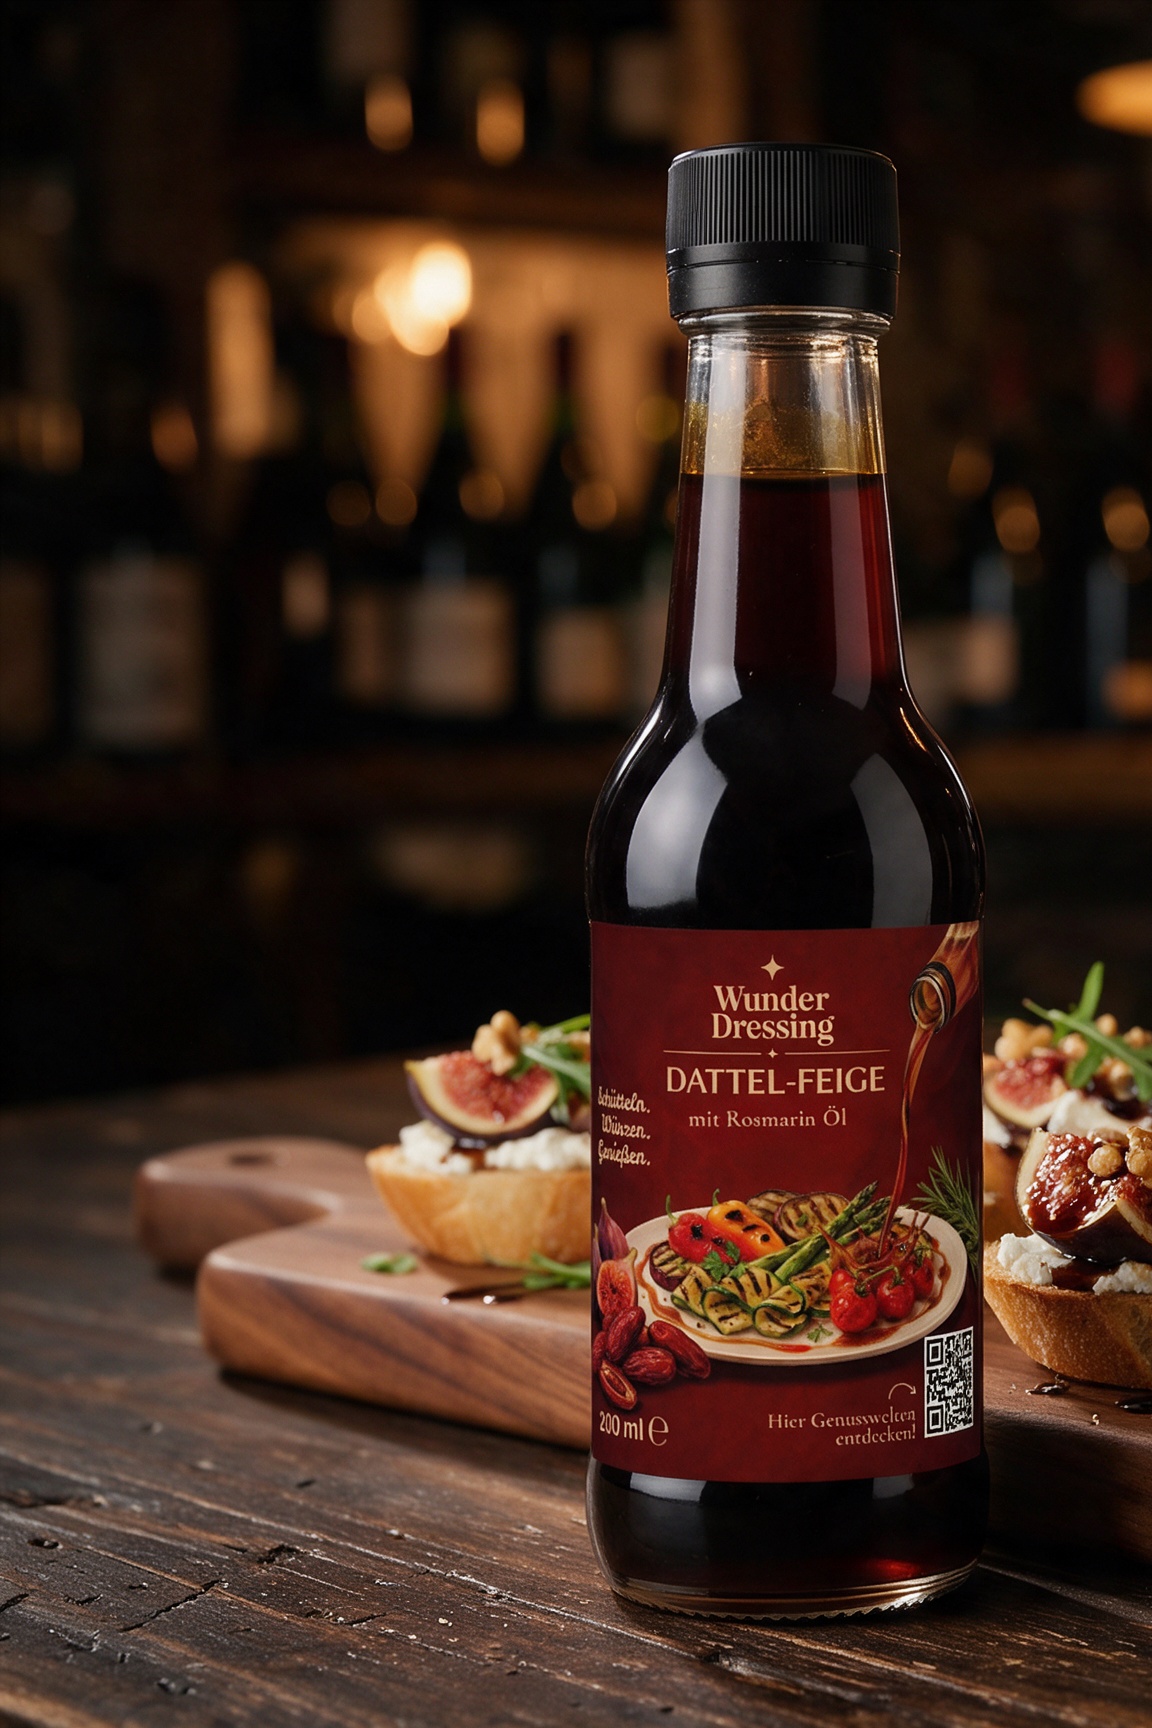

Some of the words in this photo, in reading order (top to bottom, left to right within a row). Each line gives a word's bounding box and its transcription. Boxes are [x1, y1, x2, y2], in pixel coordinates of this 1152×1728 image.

[713, 985, 830, 1012] Wunder
[711, 1013, 835, 1046] Dressing
[666, 1066, 886, 1094] DATTEL-FEIGE
[598, 1086, 651, 1114] Schütteln.
[601, 1113, 651, 1140] Würzen.
[688, 1112, 720, 1128] mit
[727, 1111, 816, 1128] Rosmarin
[824, 1107, 847, 1127] Öl
[598, 1139, 651, 1169] Genießen.
[599, 1410, 620, 1437] 200
[623, 1418, 644, 1441] ml
[768, 1412, 807, 1430] Hier
[811, 1407, 916, 1429] Genusswelten
[835, 1424, 916, 1446] entdecken!
